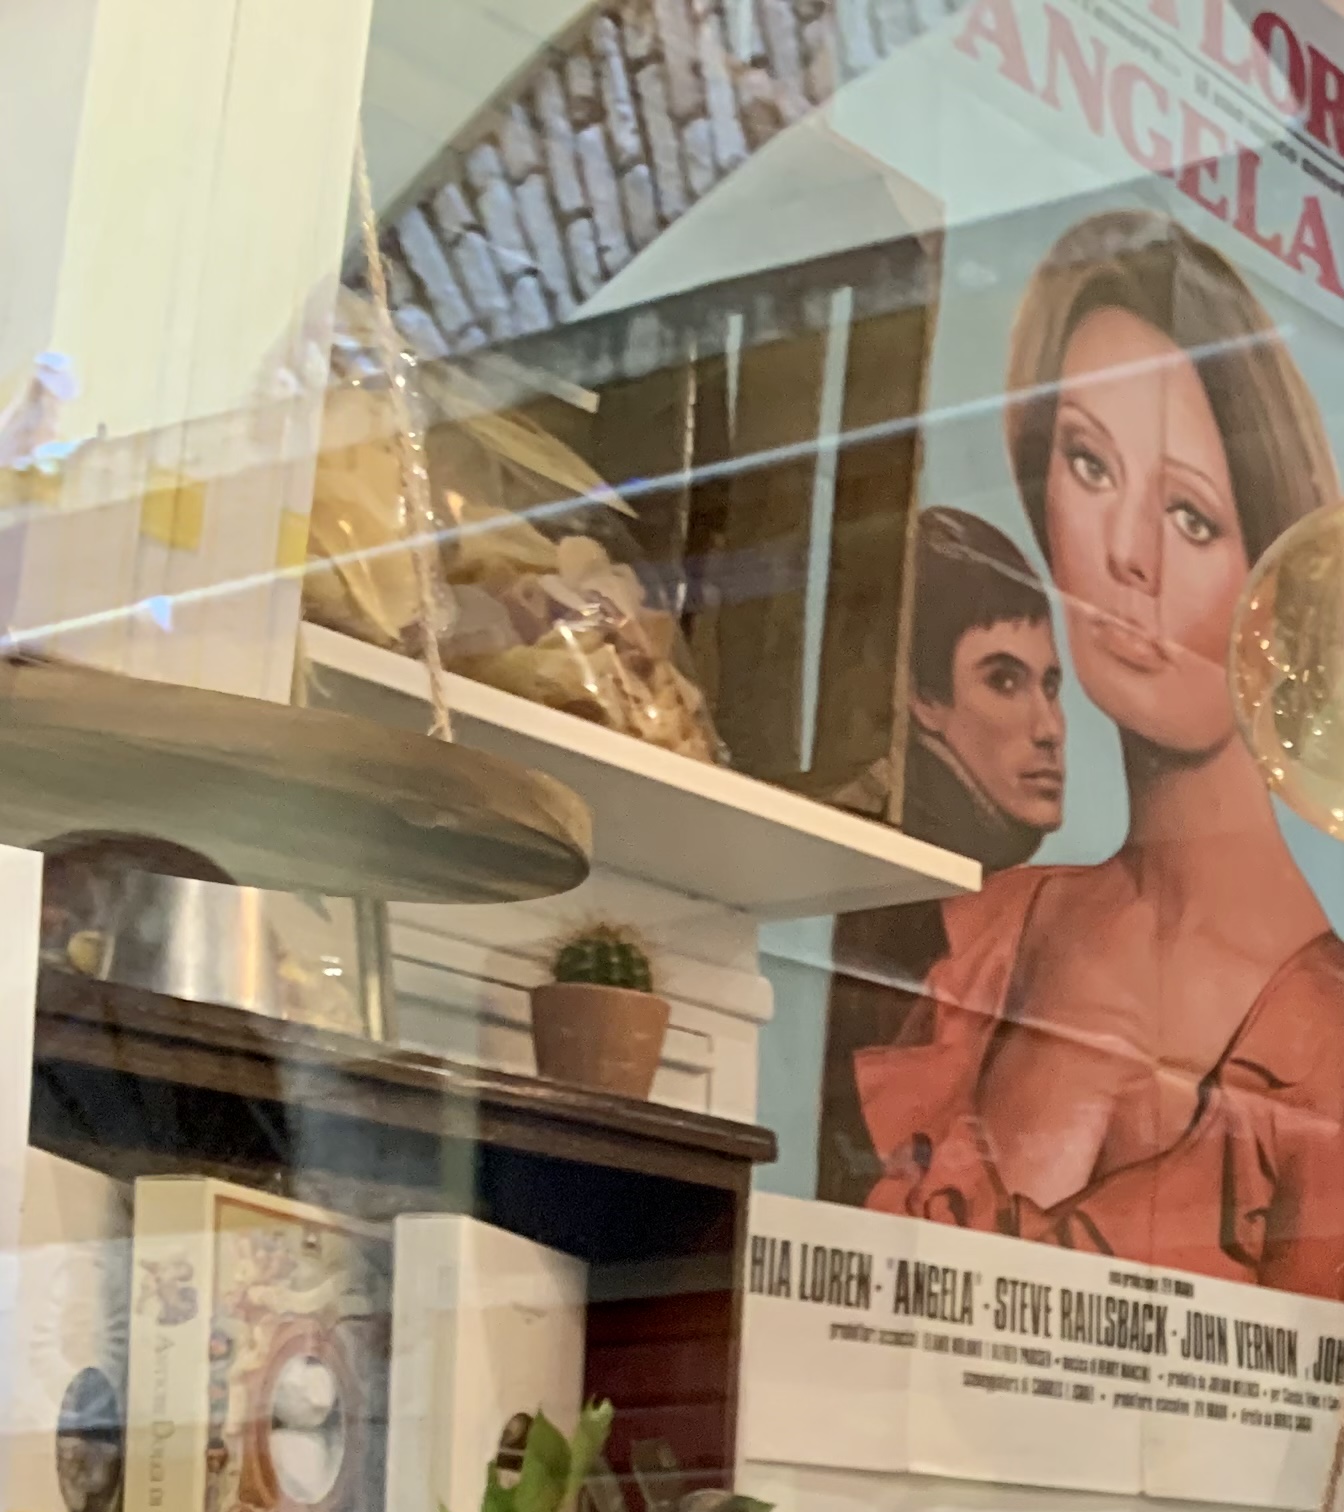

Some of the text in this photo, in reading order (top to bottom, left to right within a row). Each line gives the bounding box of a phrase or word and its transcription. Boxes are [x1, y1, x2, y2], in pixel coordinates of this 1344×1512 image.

[798, 1242, 873, 1311] LOREN
[993, 1276, 1053, 1339] STEVE
[1060, 1287, 1168, 1356] RAILSBACK
[1181, 1310, 1229, 1366] JOHN
[1234, 1319, 1298, 1378] VERNON
